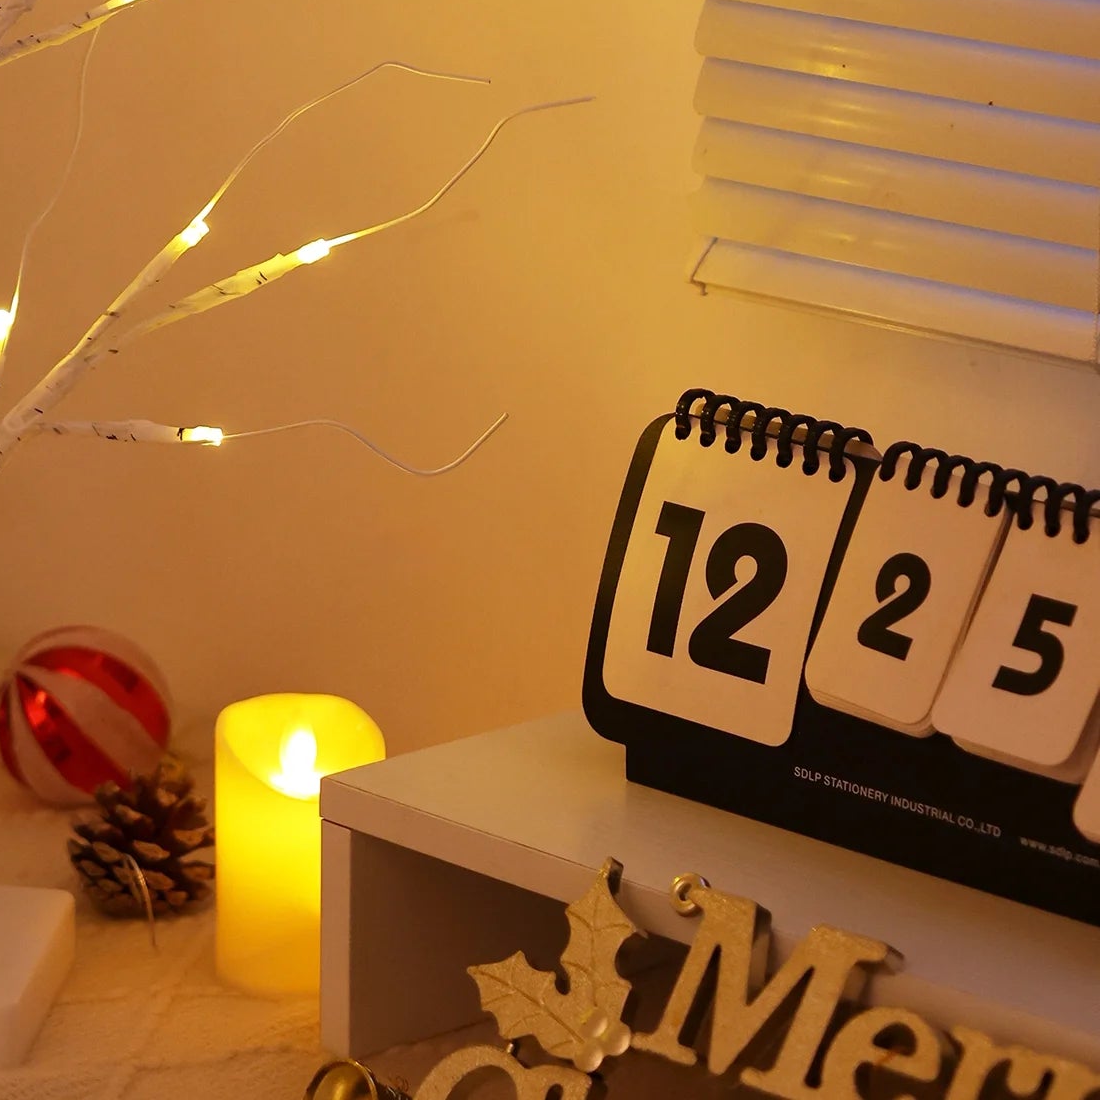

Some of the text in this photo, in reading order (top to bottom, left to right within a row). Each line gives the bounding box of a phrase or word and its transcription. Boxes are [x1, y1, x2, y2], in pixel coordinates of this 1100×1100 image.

[646, 501, 789, 685] 12
[856, 552, 932, 661] 2
[990, 594, 1079, 697] 5
[793, 765, 822, 783] SDLP
[823, 775, 889, 804] STATIONERY
[890, 795, 956, 824] INDUSTRIAL
